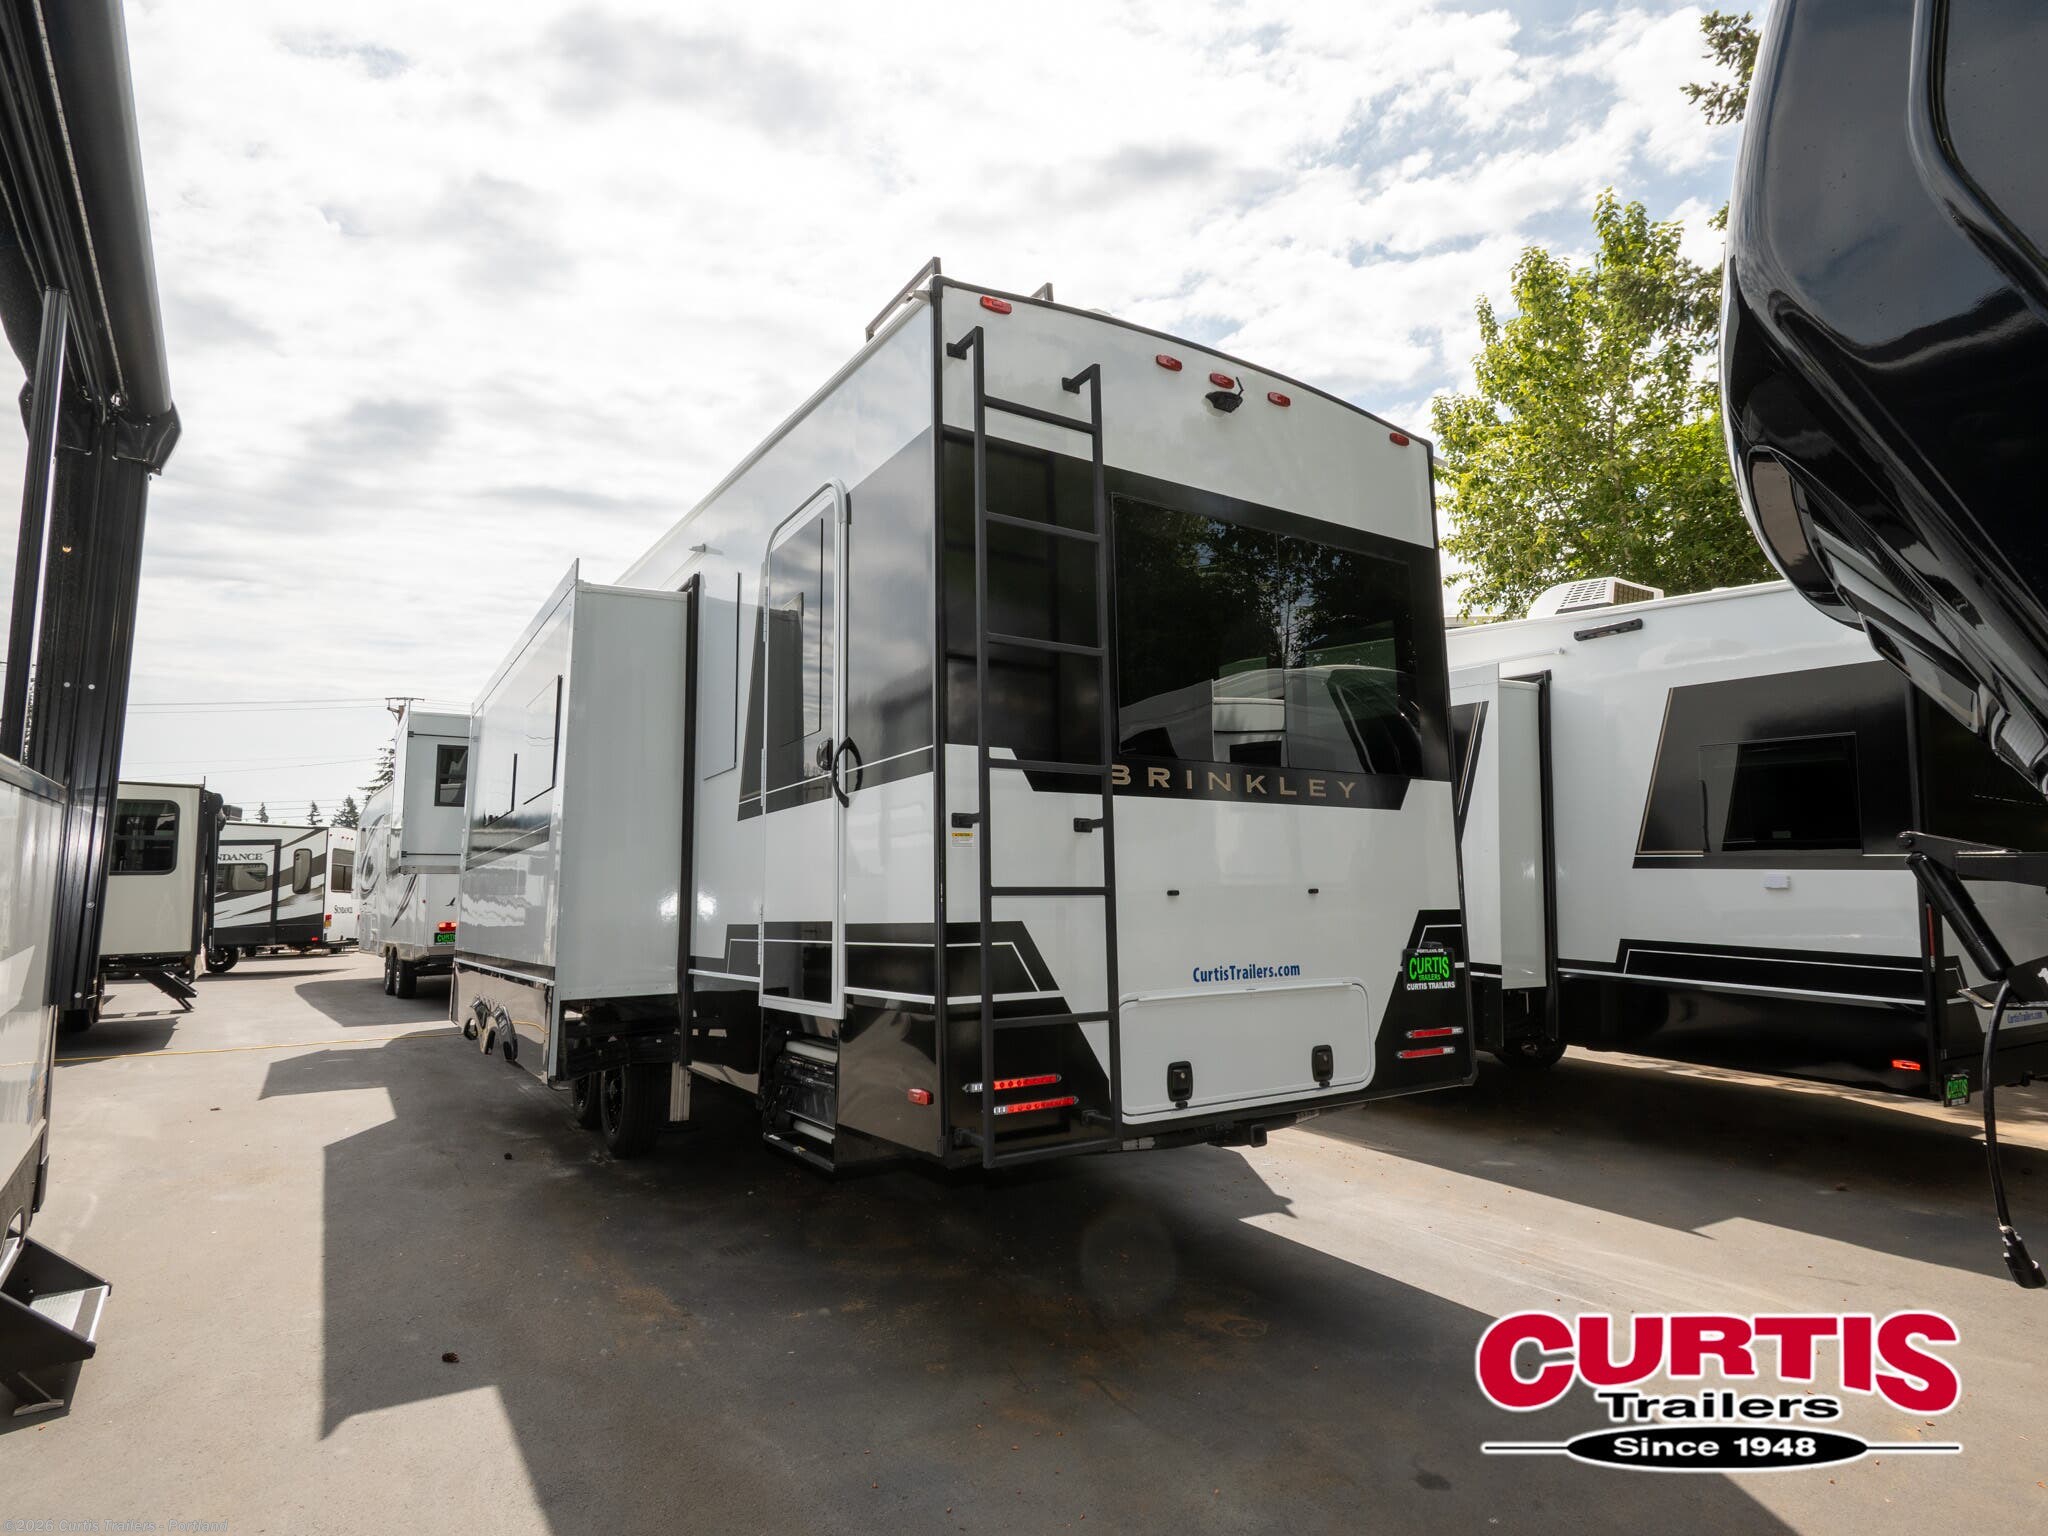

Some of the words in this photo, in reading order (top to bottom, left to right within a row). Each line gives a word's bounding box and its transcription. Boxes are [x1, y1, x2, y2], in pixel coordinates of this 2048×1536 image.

[1112, 764, 1356, 799] BRINKLEY
[1192, 964, 1301, 982] CurtisTrailers.com
[1409, 956, 1450, 980] CURTIS
[1428, 981, 1456, 989] TRAILERS
